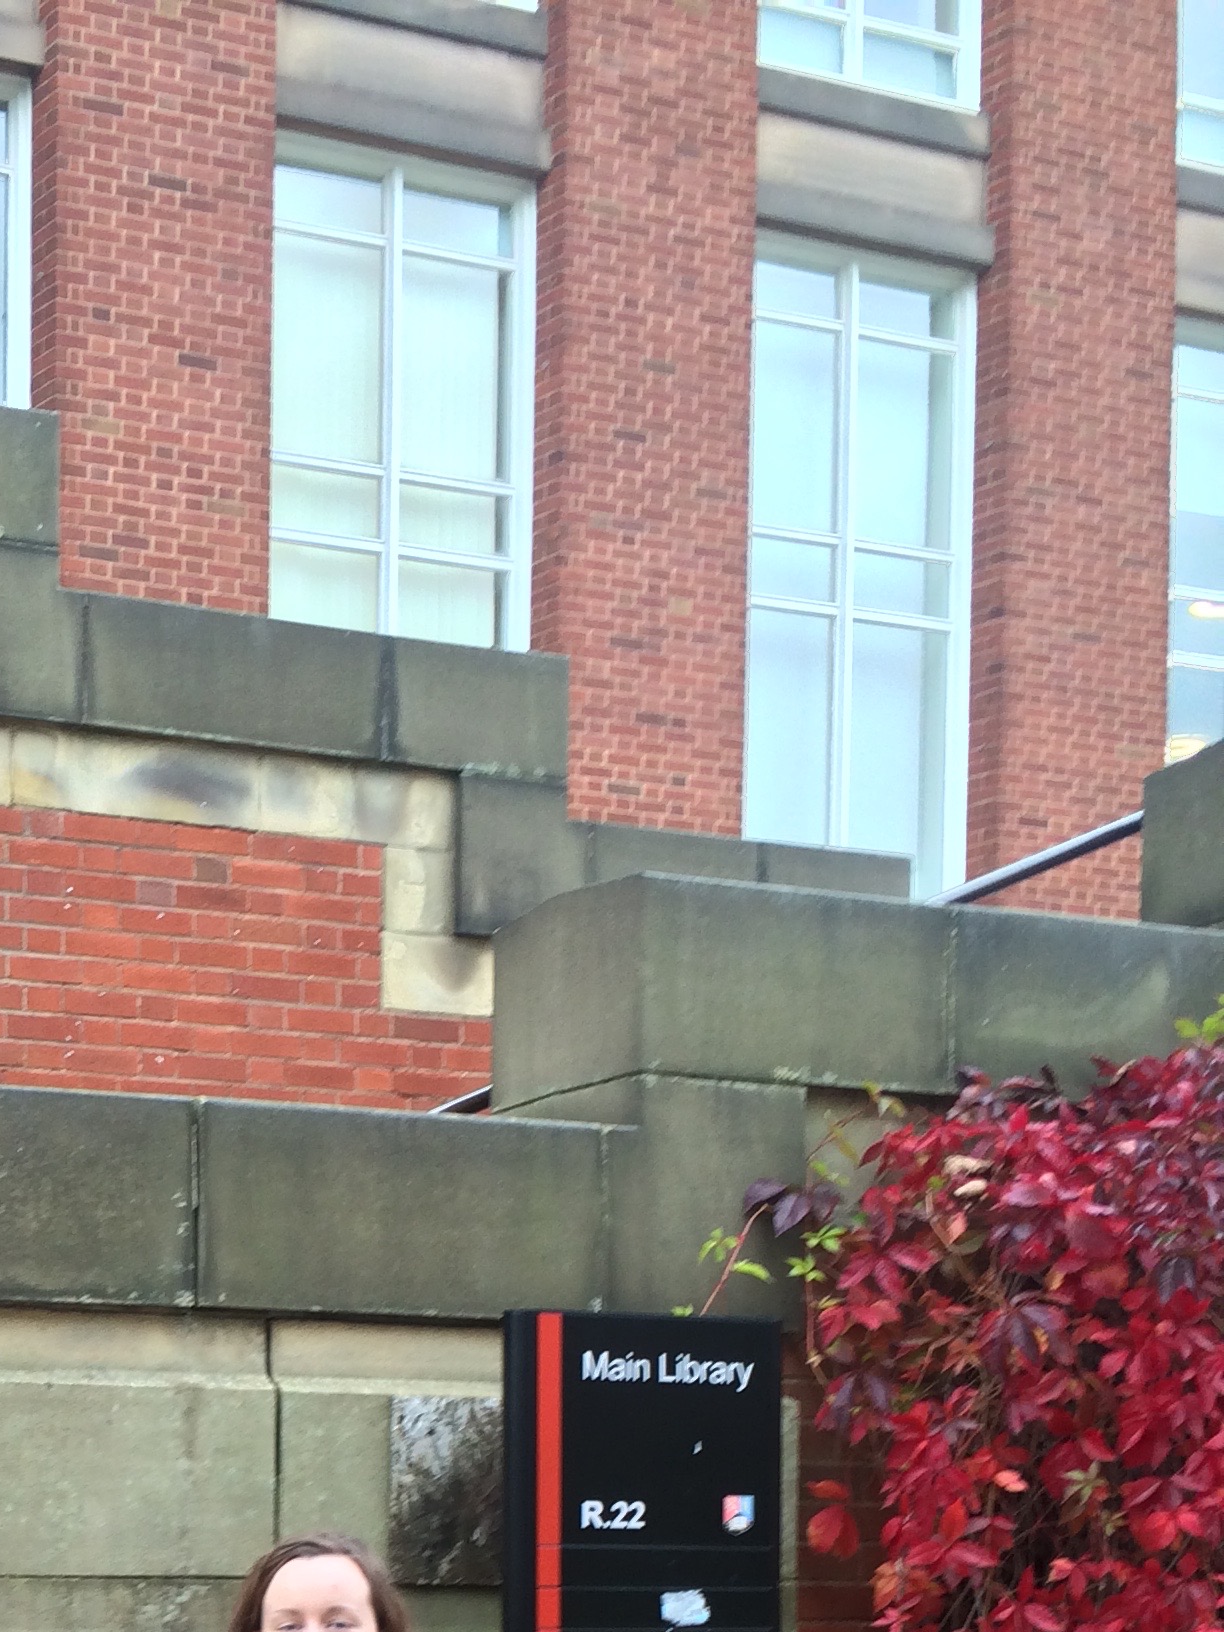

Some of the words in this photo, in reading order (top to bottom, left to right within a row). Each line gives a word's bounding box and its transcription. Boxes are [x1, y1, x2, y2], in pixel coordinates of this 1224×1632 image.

[581, 1350, 651, 1382] Main
[658, 1352, 755, 1393] Library
[580, 1500, 646, 1530] R.22
